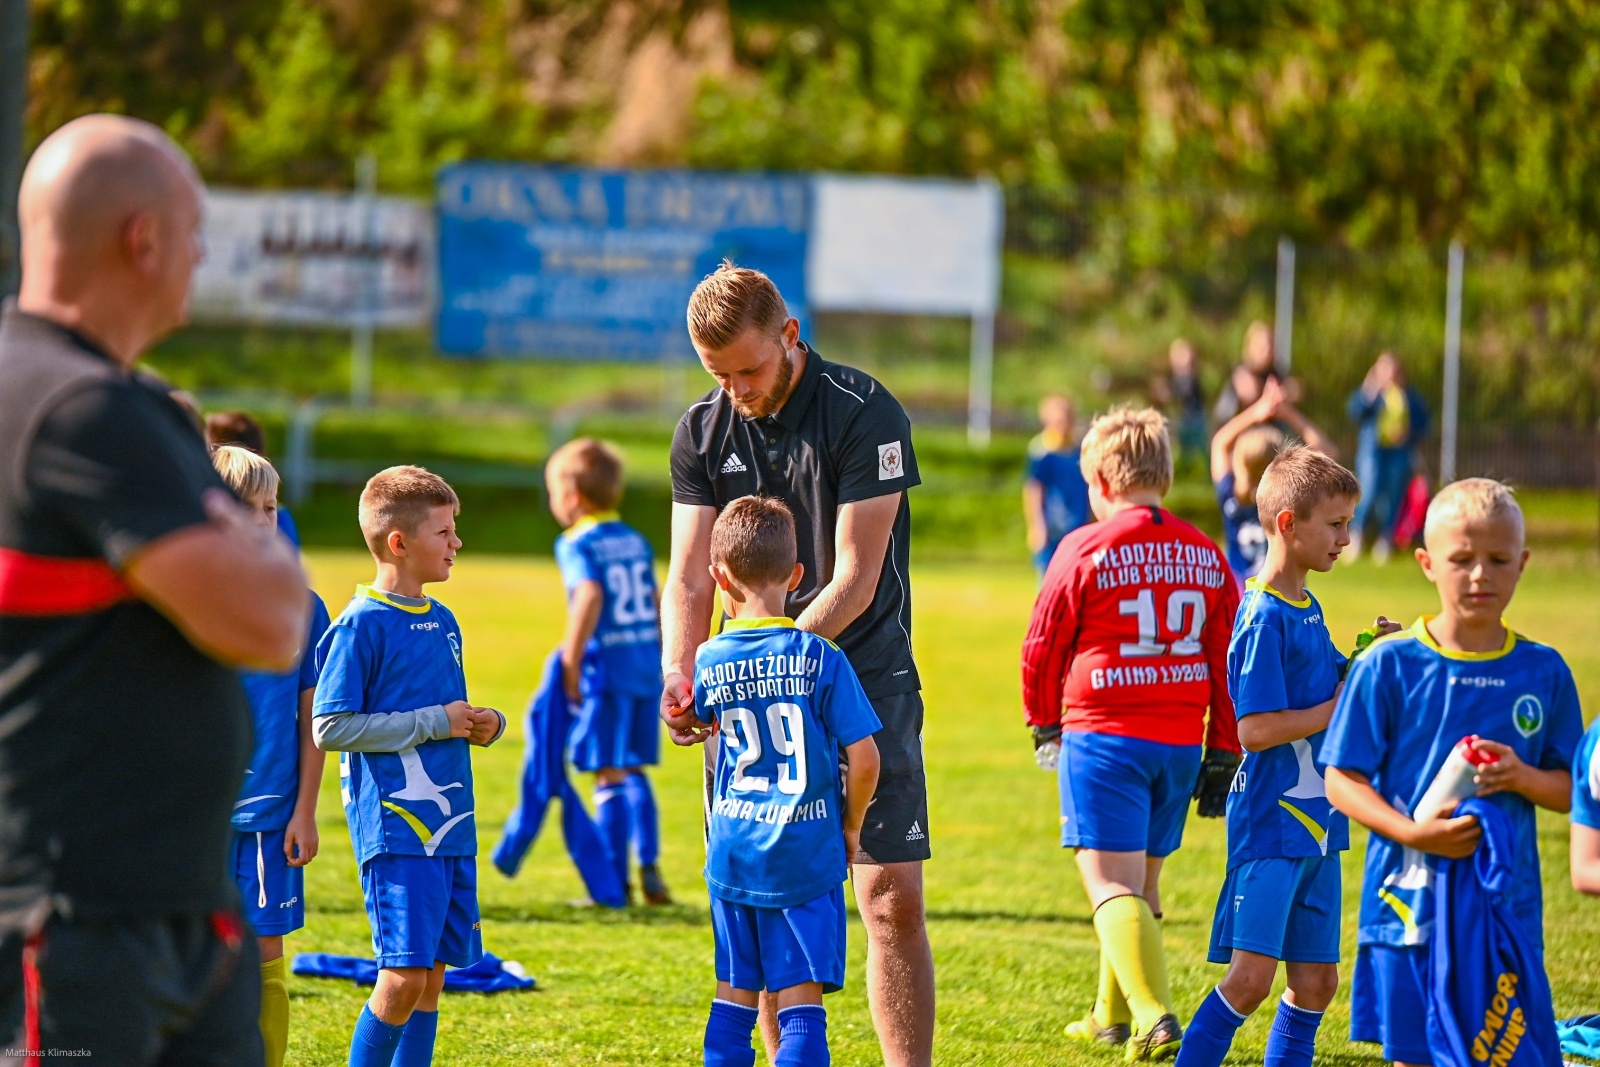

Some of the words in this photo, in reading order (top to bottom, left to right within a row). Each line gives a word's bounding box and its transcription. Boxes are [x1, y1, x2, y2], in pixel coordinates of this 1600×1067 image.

[721, 464, 747, 473] adidas
[1097, 565, 1141, 590] KLUB
[1144, 564, 1226, 590] SPORTOWY
[1119, 588, 1207, 658] 12
[701, 651, 818, 688] MŁODZIEŻOWY
[1091, 666, 1158, 690] GMINA
[736, 677, 816, 701] SPORTOWY
[721, 702, 808, 795] 29
[905, 832, 925, 841] adidas
